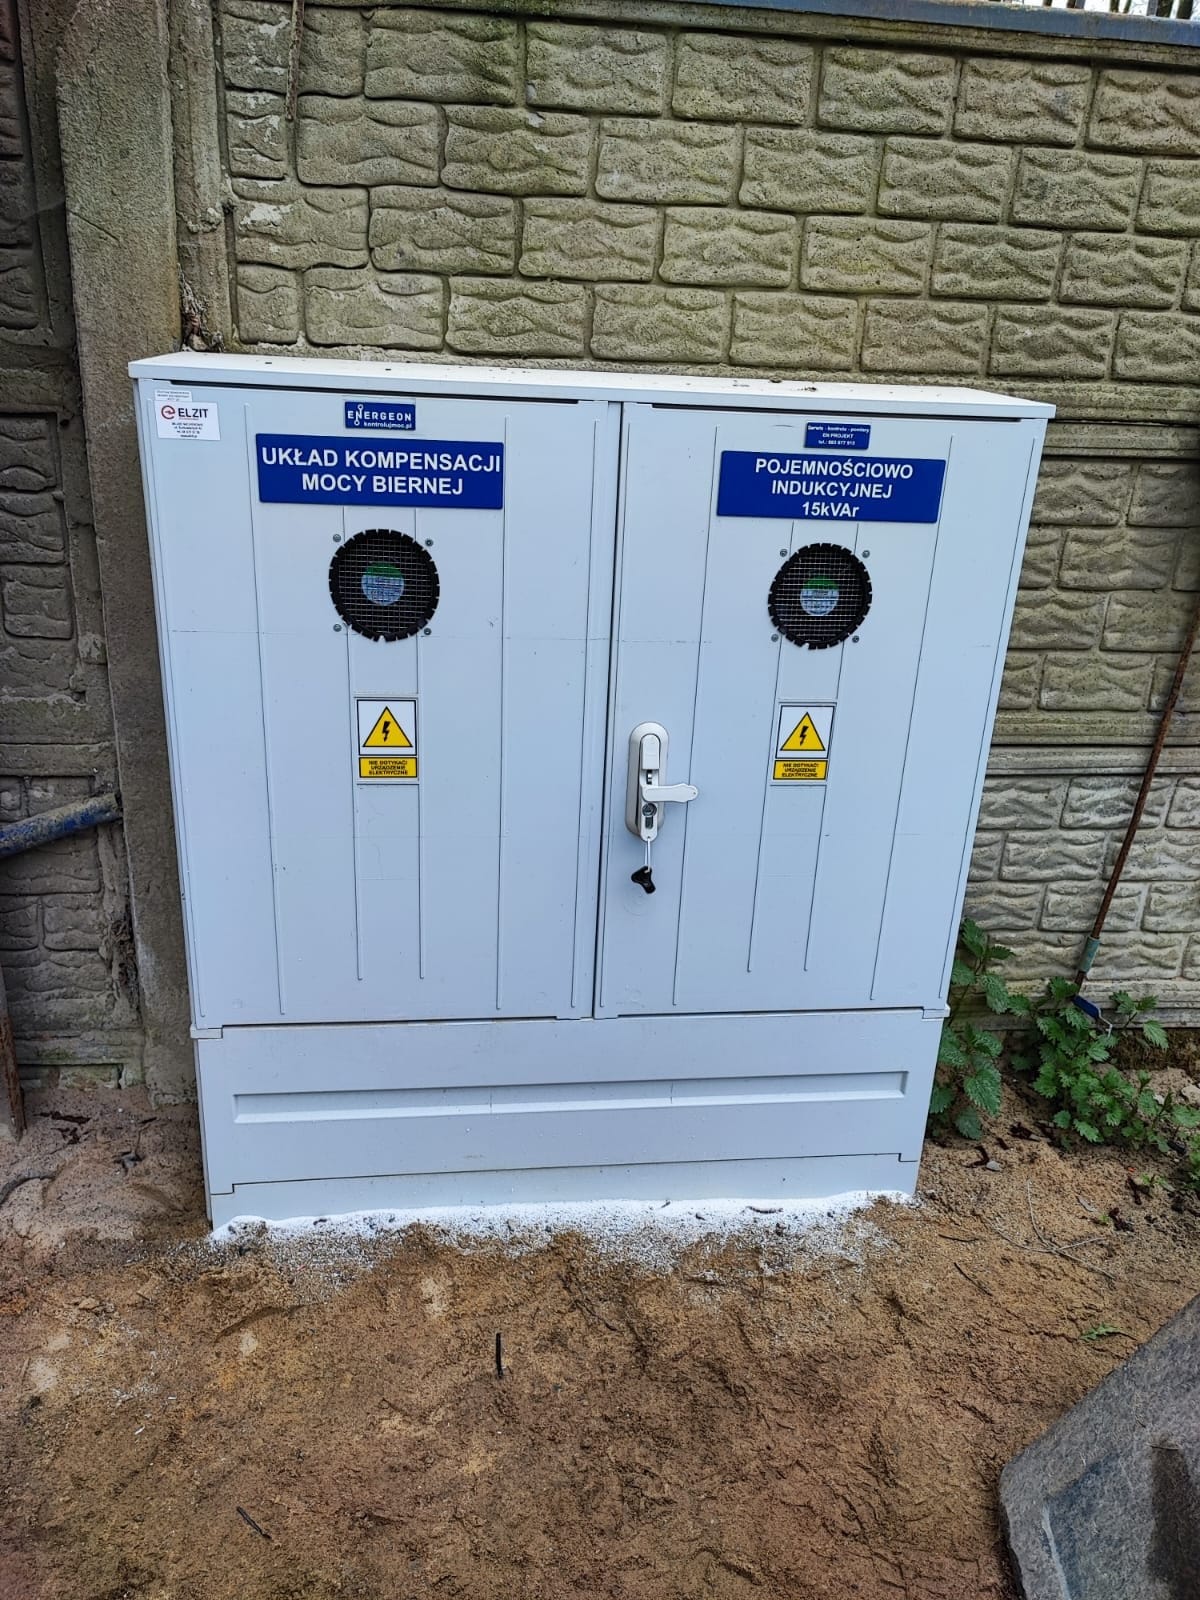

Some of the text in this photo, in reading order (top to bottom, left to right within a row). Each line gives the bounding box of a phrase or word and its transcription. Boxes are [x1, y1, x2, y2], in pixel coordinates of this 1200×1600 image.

[178, 408, 208, 418] ELZIT
[347, 407, 412, 423] ENERGEON
[262, 447, 500, 473] UKŁAD KOMPENSACJI
[755, 458, 913, 479] POJEMNOŚCIOWO
[302, 473, 464, 495] MOCY BIERNEJ
[771, 480, 893, 499] INDUKCYJNEJ
[802, 502, 860, 518] 15kVAr
